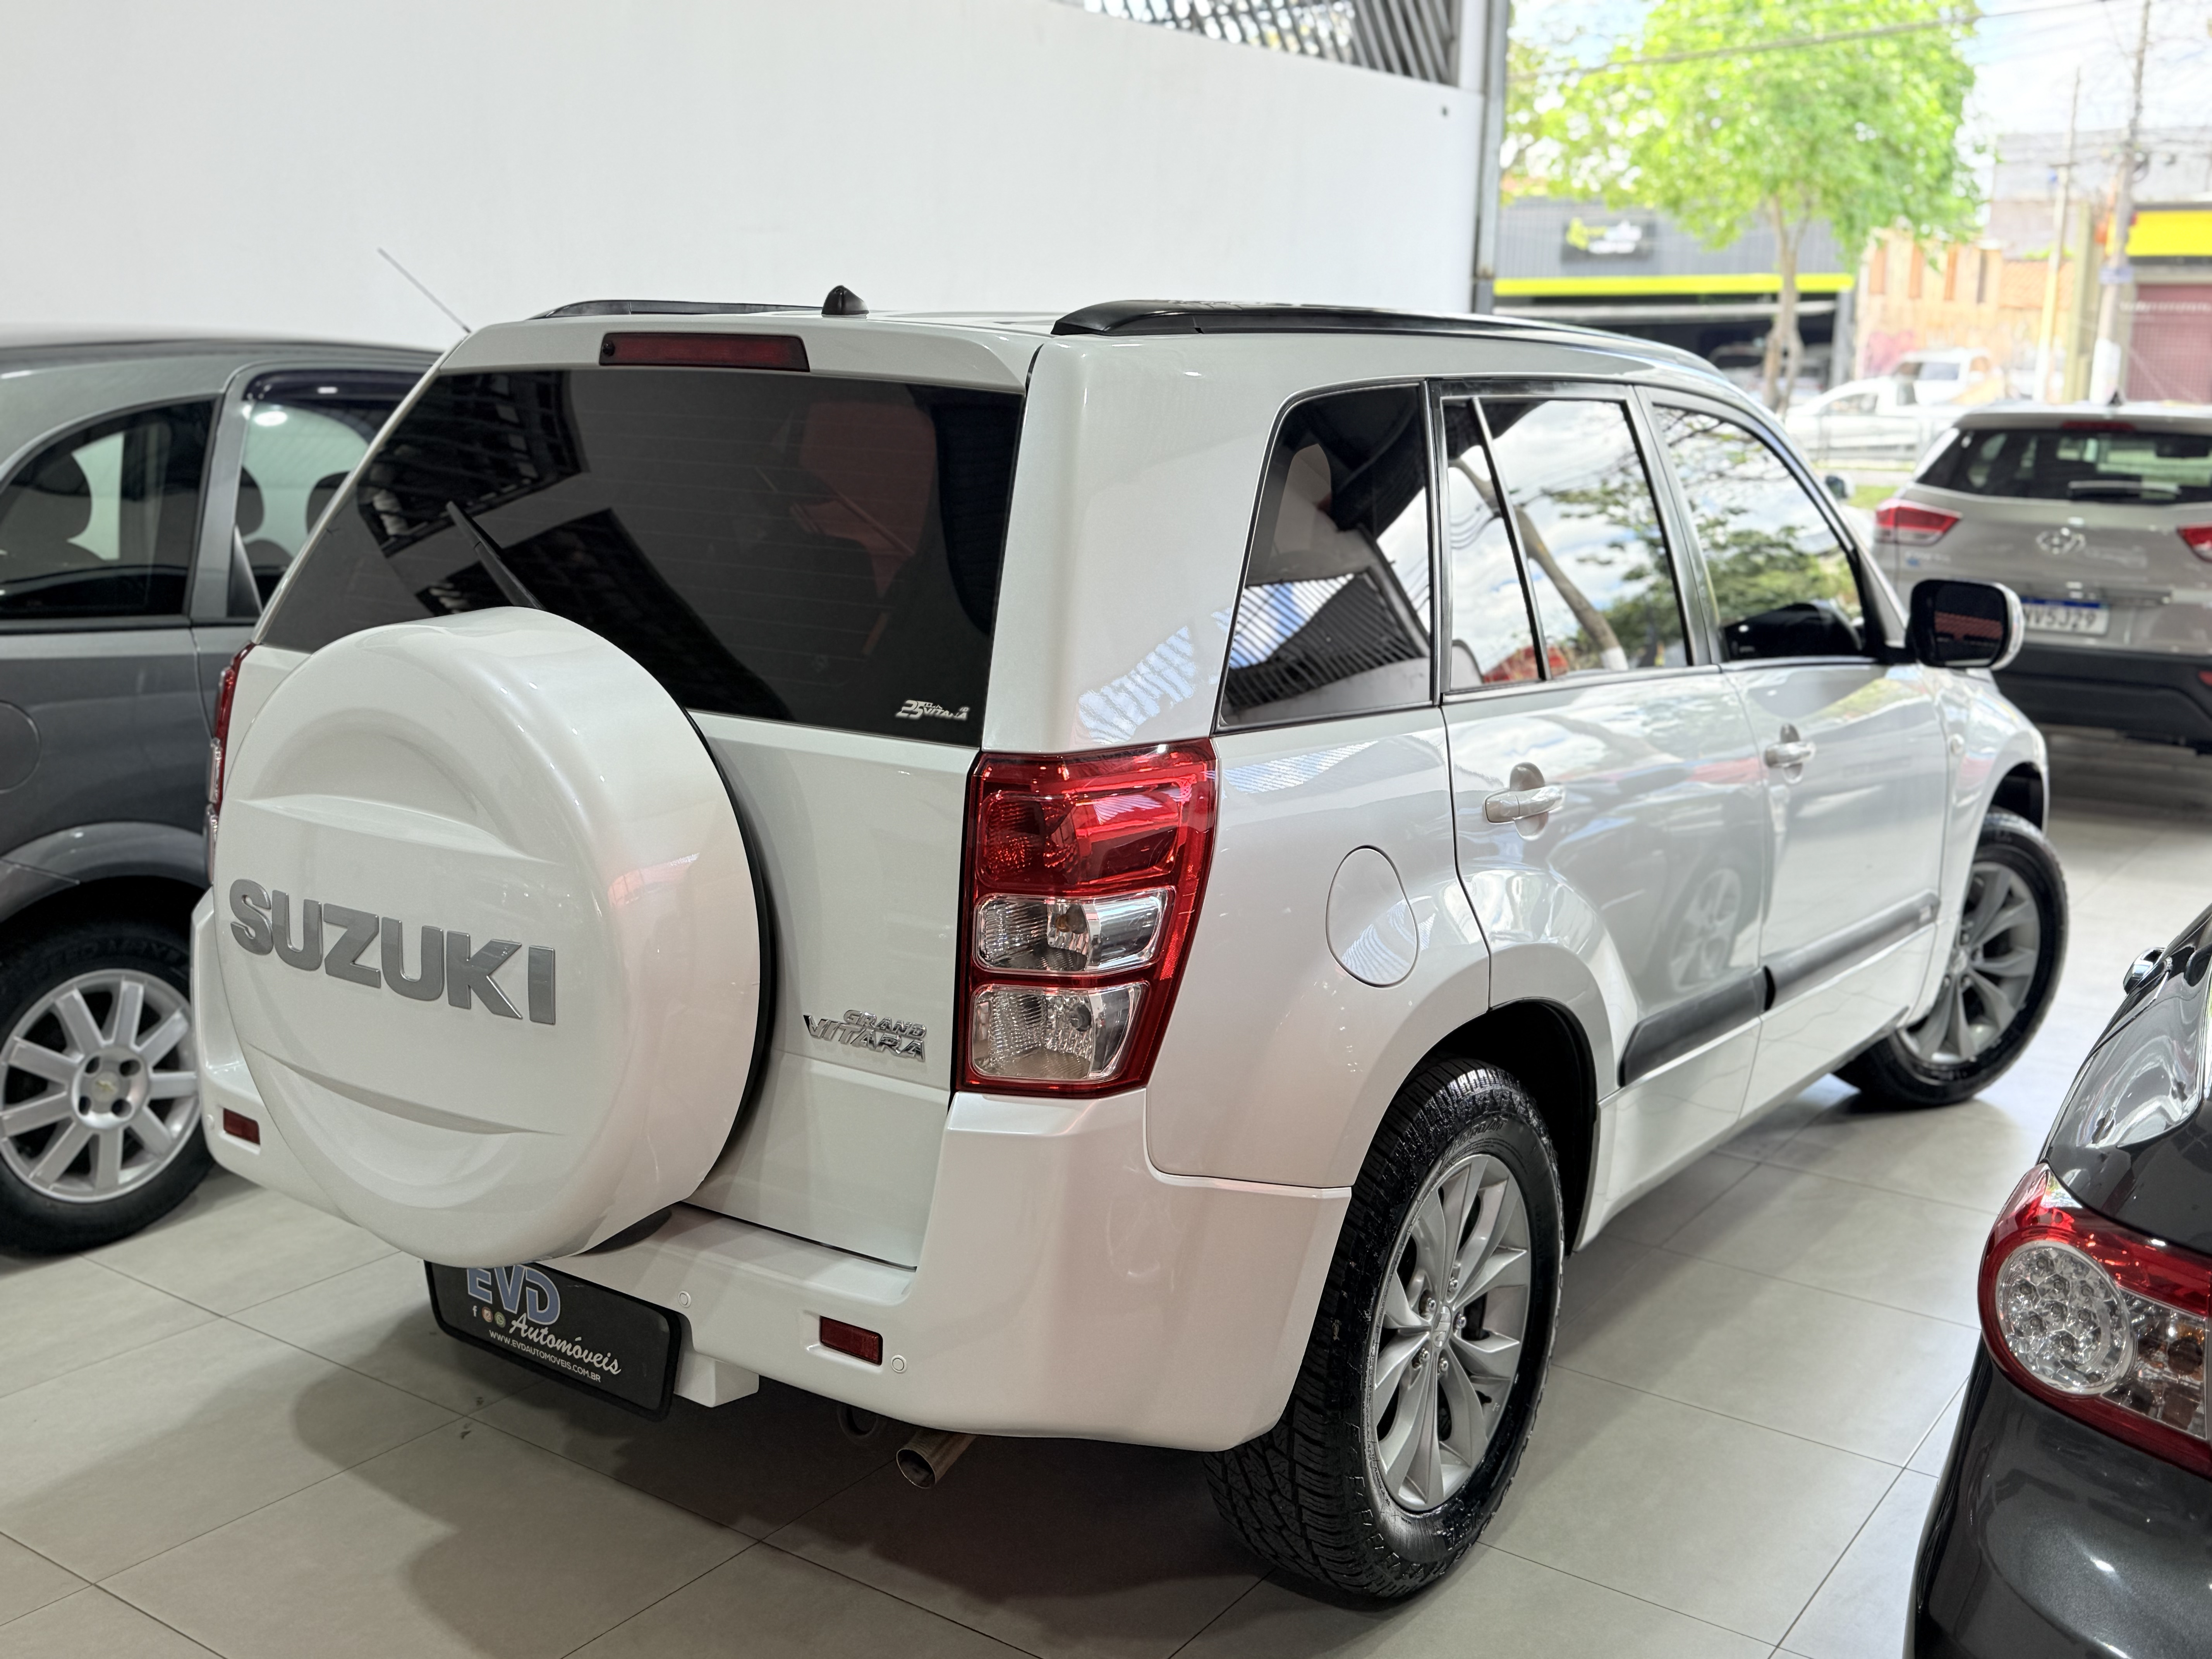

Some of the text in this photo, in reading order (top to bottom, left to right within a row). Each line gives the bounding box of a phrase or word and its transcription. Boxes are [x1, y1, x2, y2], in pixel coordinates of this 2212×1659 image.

[229, 878, 555, 1025] SUZUKI
[803, 1014, 926, 1062] VITARA
[843, 1009, 927, 1039] GRAND
[467, 1264, 561, 1326] EVD
[489, 1329, 601, 1383] WWW.EVDAUTOMOVEIS.COM.BR
[509, 1312, 622, 1375] Automóveis
